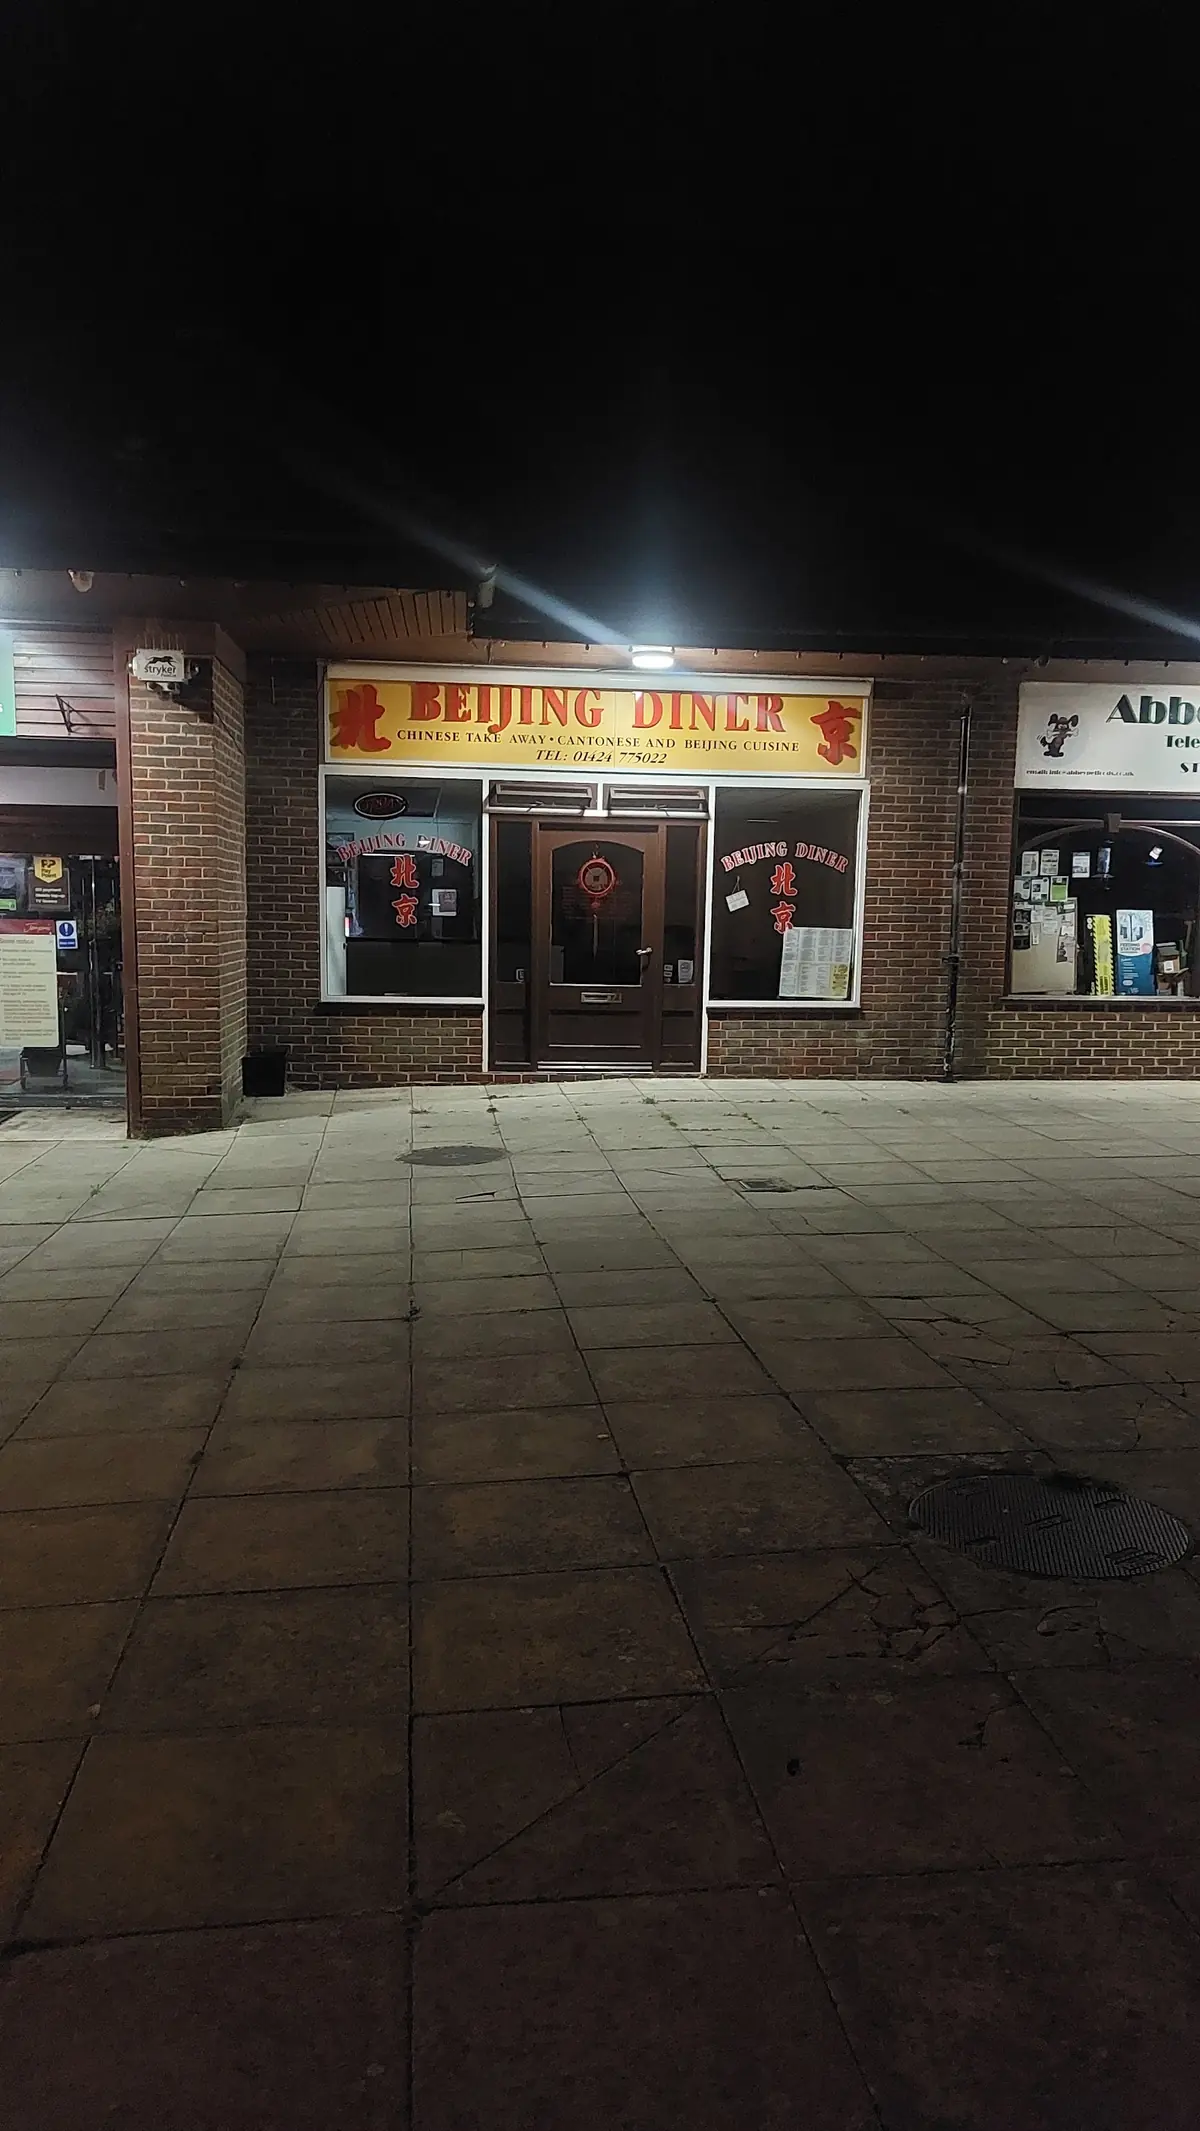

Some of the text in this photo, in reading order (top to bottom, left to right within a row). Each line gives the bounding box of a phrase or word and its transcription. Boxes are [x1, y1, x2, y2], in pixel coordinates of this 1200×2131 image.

[144, 665, 176, 675] stryker
[328, 683, 392, 752] 北
[407, 681, 786, 734] BEIJING DINER
[1106, 694, 1200, 725] Abb
[397, 729, 460, 742] CHINESE
[465, 732, 502, 744] TAKE
[646, 738, 676, 749] AND
[684, 739, 738, 752] BEIJING
[744, 740, 799, 752] CUISINE
[810, 700, 863, 766] 京
[535, 749, 667, 764] TEL: 01424 775022
[336, 832, 473, 867] BEIJING DINER
[720, 841, 849, 874] BEIJING DINER
[389, 853, 420, 928] 北京
